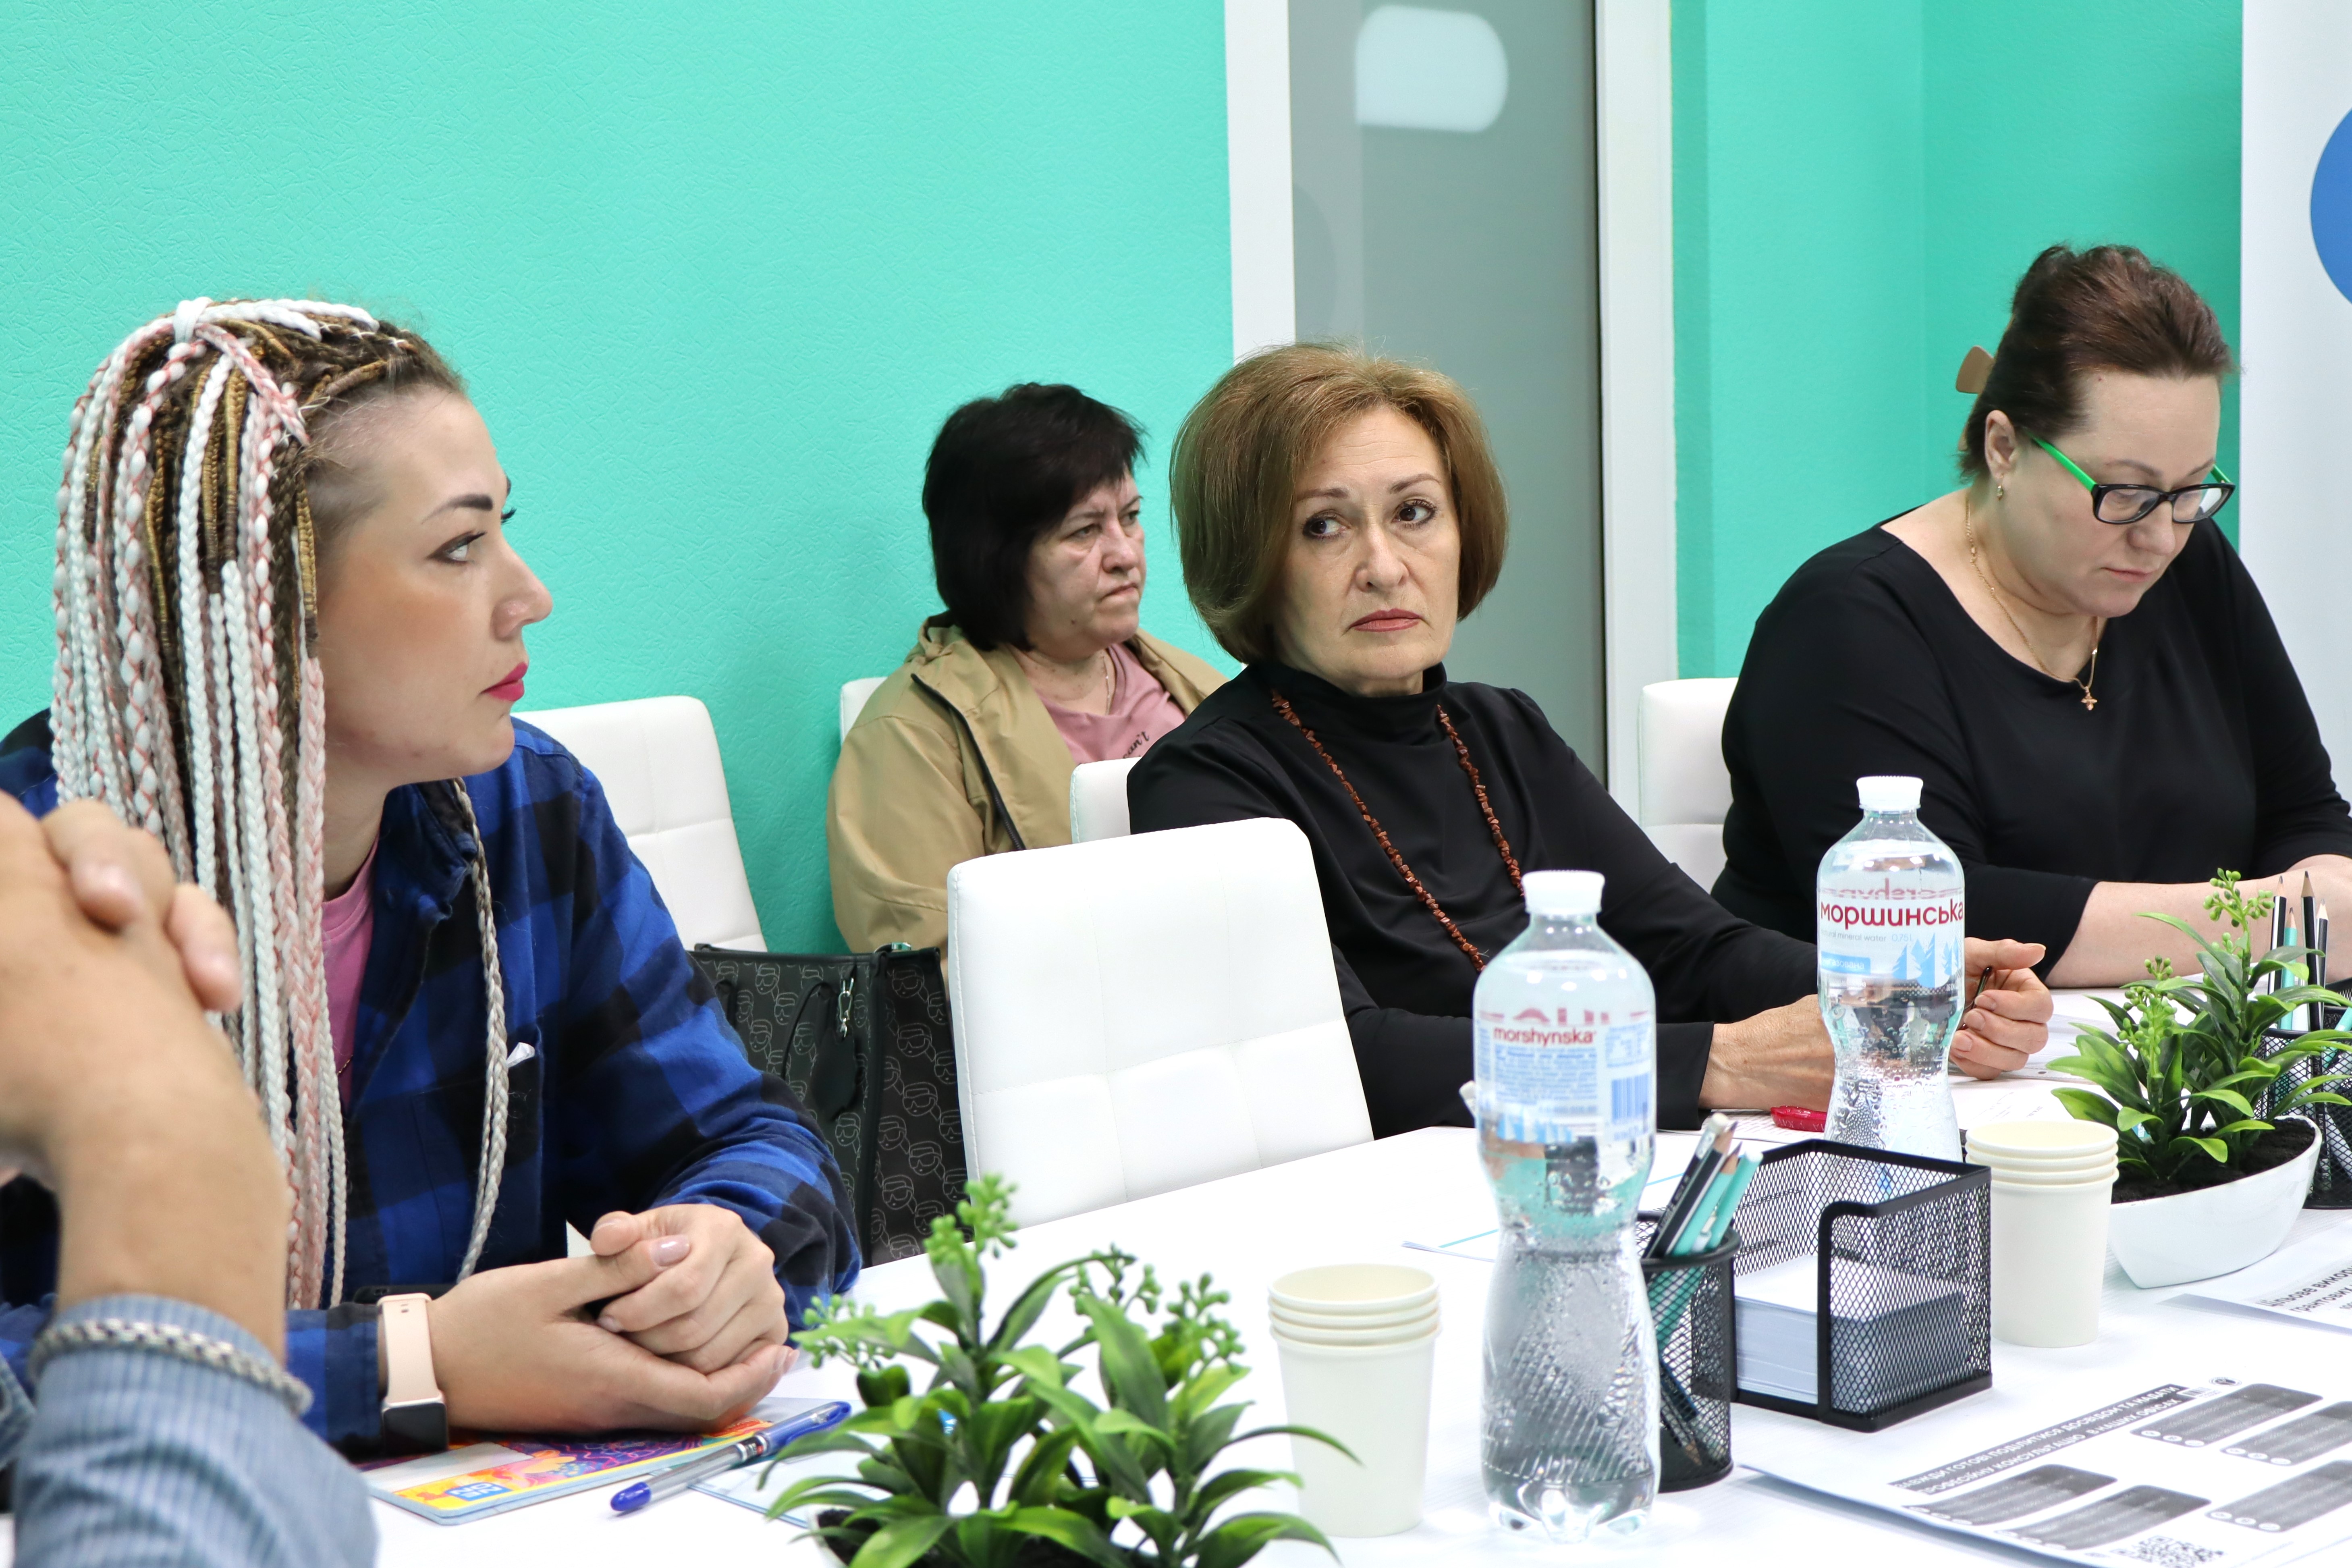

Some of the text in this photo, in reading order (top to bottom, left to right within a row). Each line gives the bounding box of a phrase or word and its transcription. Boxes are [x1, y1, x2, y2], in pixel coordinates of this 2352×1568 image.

[1821, 899, 1963, 930] моршинська
[1837, 932, 1862, 941] mineral
[1493, 1027, 1593, 1047] morshynska
[2255, 1288, 2318, 1307] Цільове
[2096, 1414, 2142, 1432] НАШИХ
[2136, 1398, 2183, 1416] ОФІСАХ
[1946, 1454, 1992, 1472] ГОТОВІ
[1988, 1428, 2065, 1457] ПОДІЛИТИСЯ
[2061, 1406, 2124, 1431] ДОСВІДОМ
[2118, 1399, 2137, 1409] ТА
[2132, 1386, 2180, 1405] НАДАТИ
